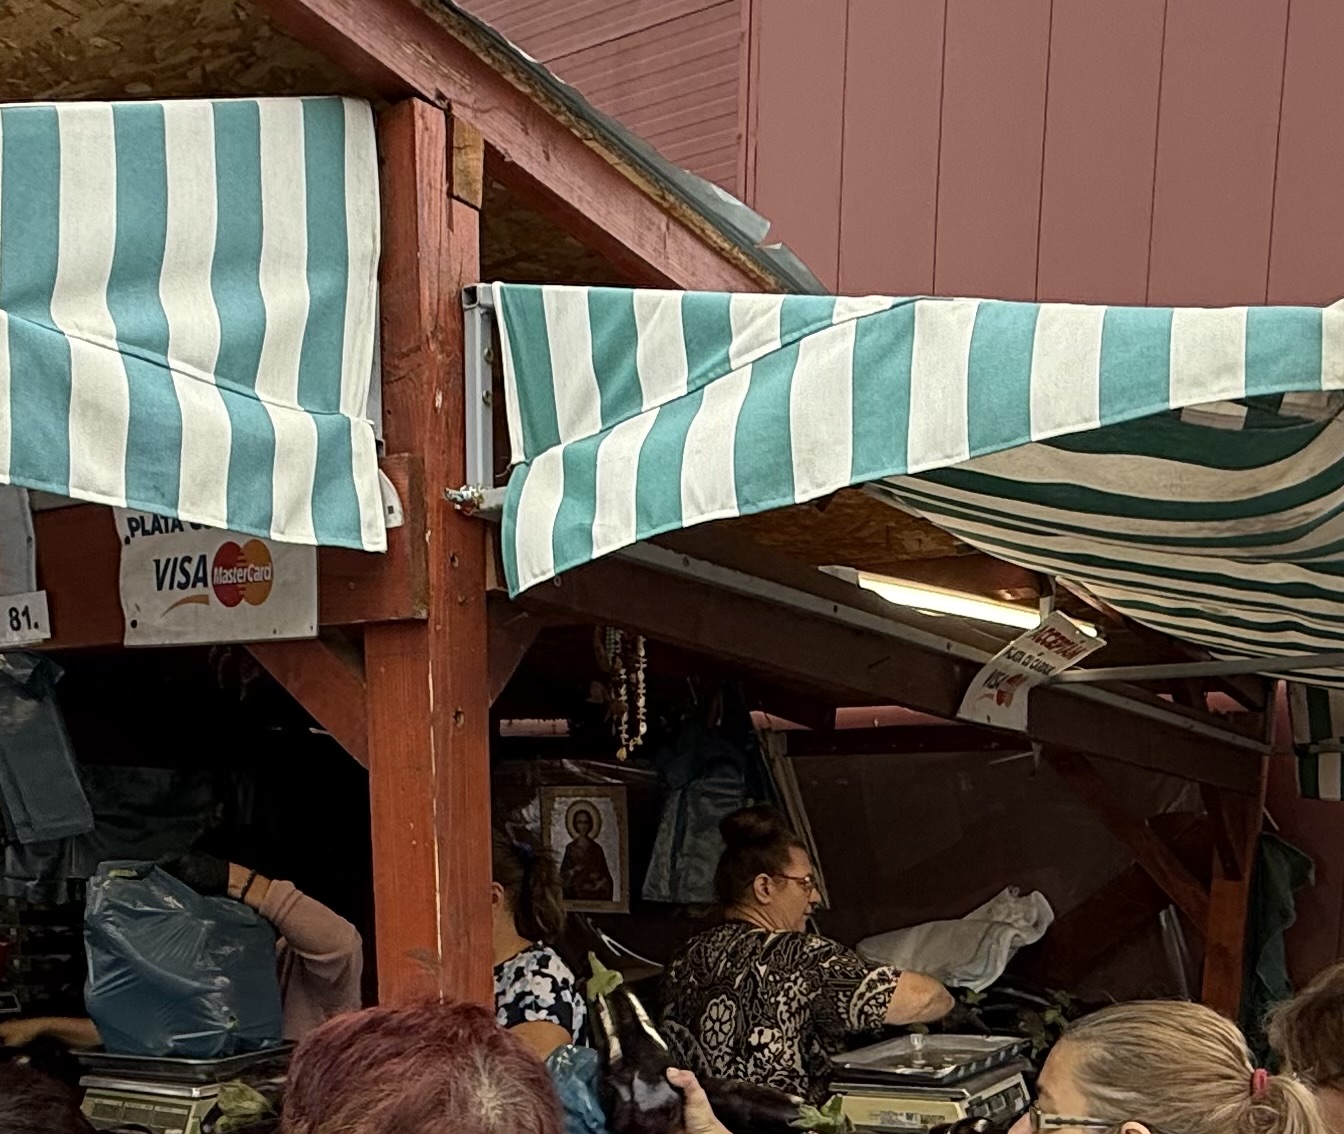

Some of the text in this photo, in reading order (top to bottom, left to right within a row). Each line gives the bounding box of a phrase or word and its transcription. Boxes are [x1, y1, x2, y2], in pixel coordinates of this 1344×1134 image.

[127, 515, 183, 538] PLATA
[153, 554, 209, 591] VISA
[212, 563, 272, 585] MasterCard
[8, 605, 39, 631] 81.
